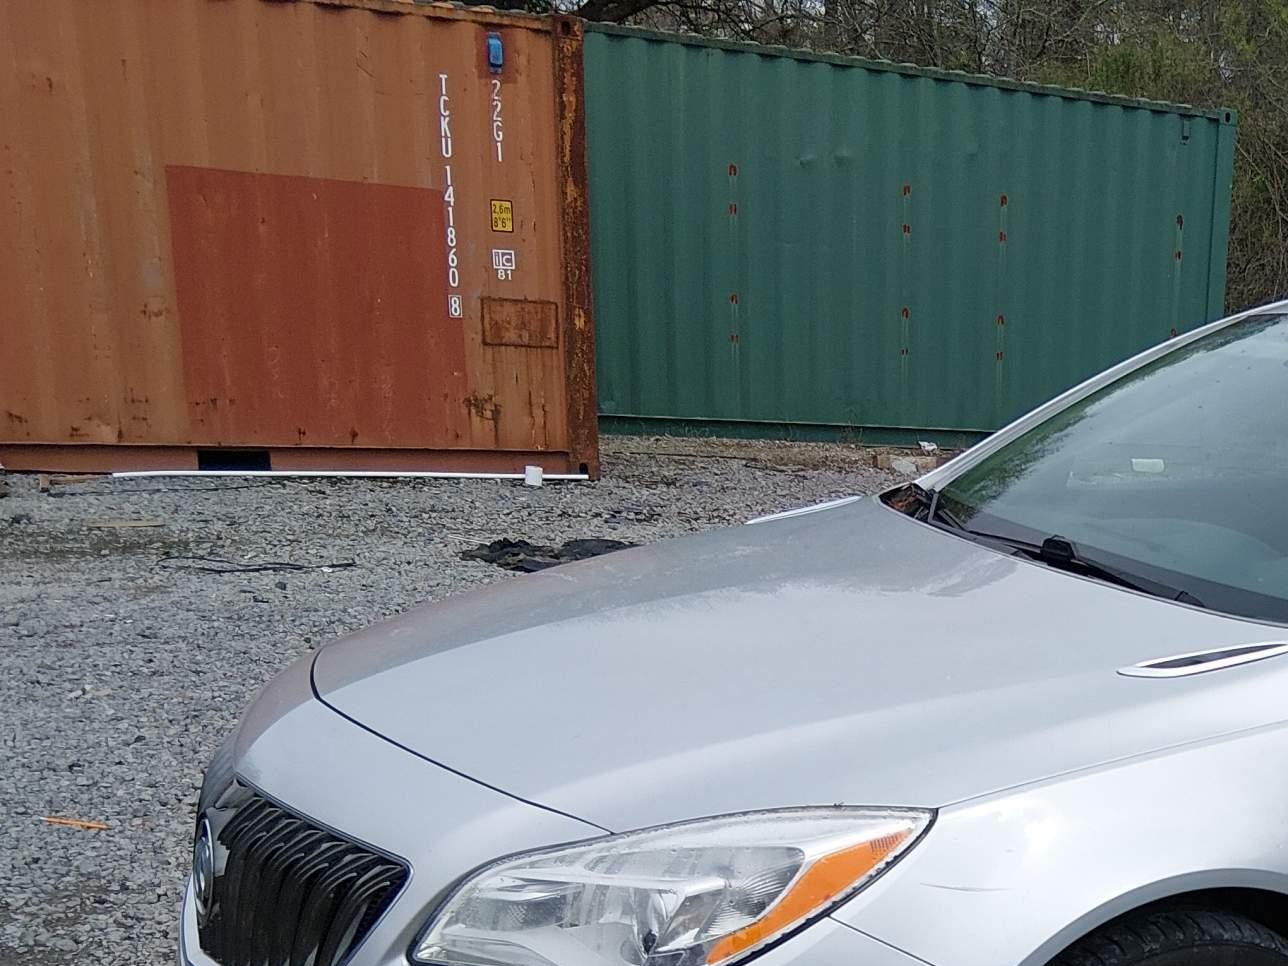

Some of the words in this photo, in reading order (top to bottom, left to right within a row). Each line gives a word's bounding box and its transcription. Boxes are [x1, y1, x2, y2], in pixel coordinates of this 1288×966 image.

[439, 74, 452, 157] TCKU
[491, 80, 503, 161] 22G1
[445, 166, 459, 287] 141860
[497, 269, 512, 280] 81
